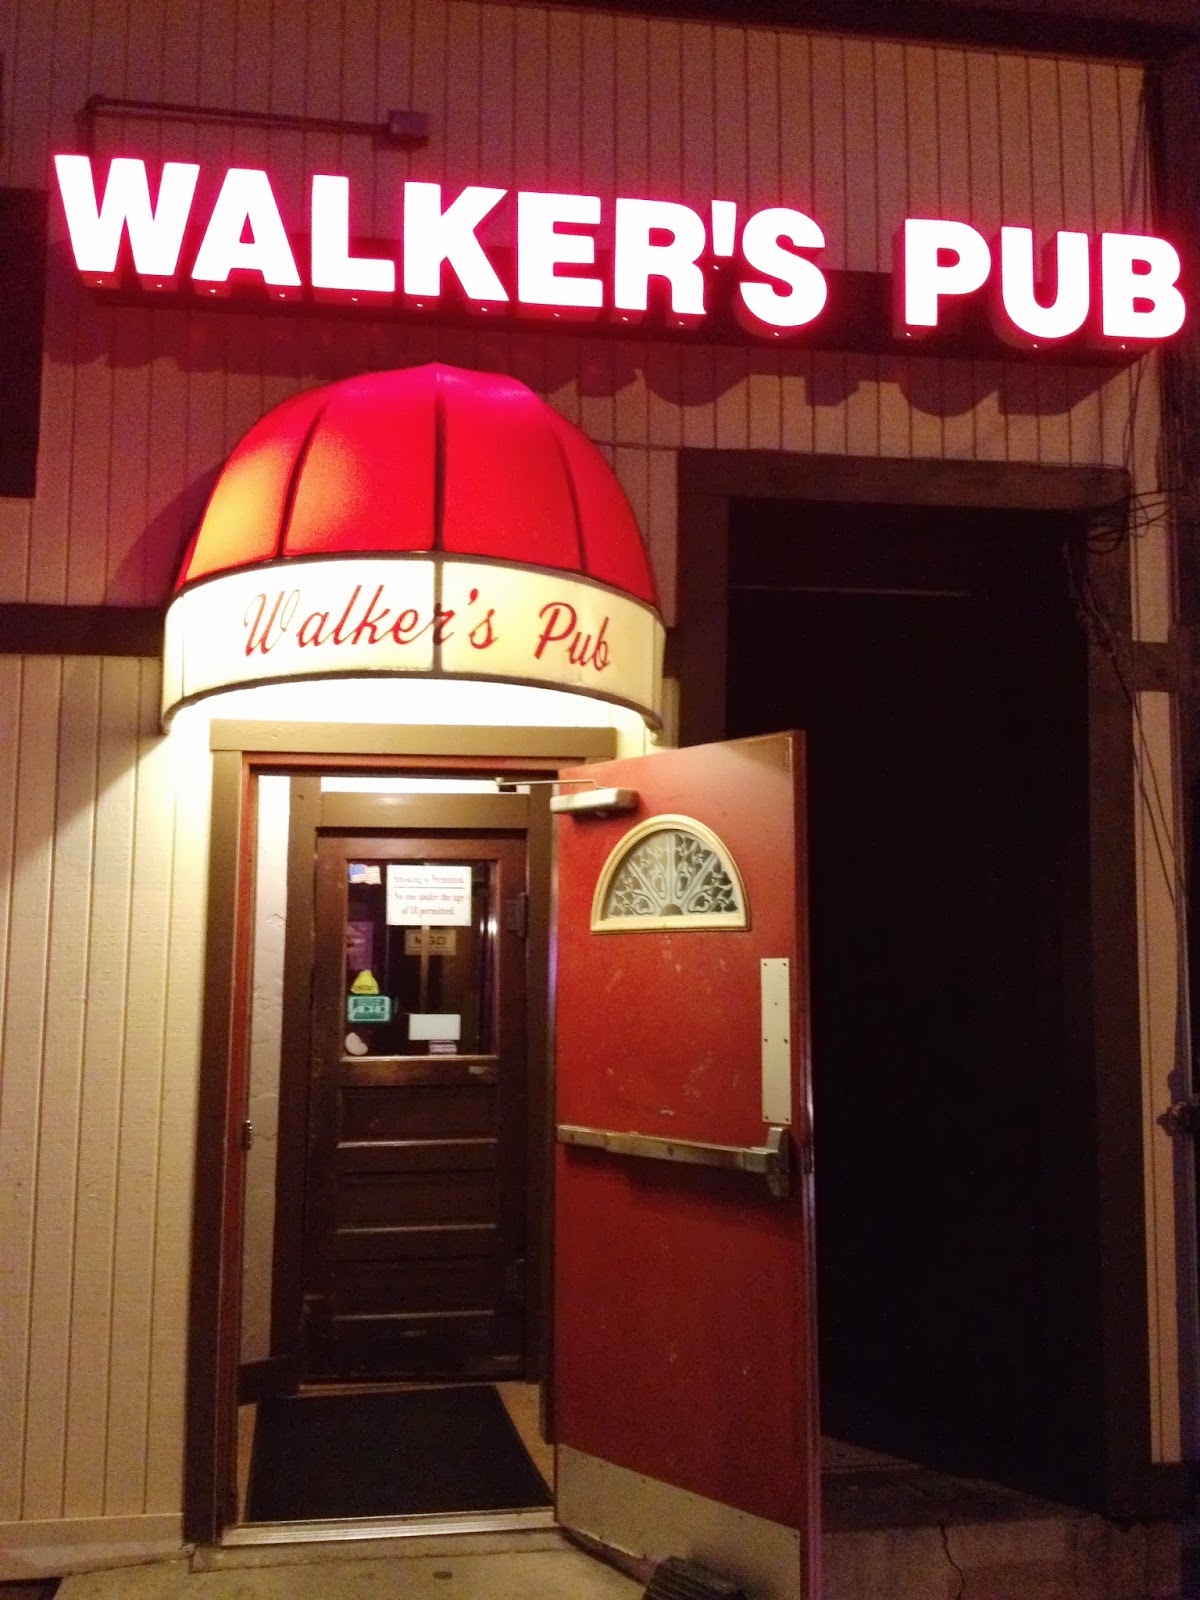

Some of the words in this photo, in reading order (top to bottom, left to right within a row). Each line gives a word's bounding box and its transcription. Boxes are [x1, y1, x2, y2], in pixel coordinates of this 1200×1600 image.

[54, 154, 828, 328] WALKER'S
[904, 218, 1186, 339] PUB
[243, 584, 499, 657] Walker's
[538, 601, 612, 671] Pub
